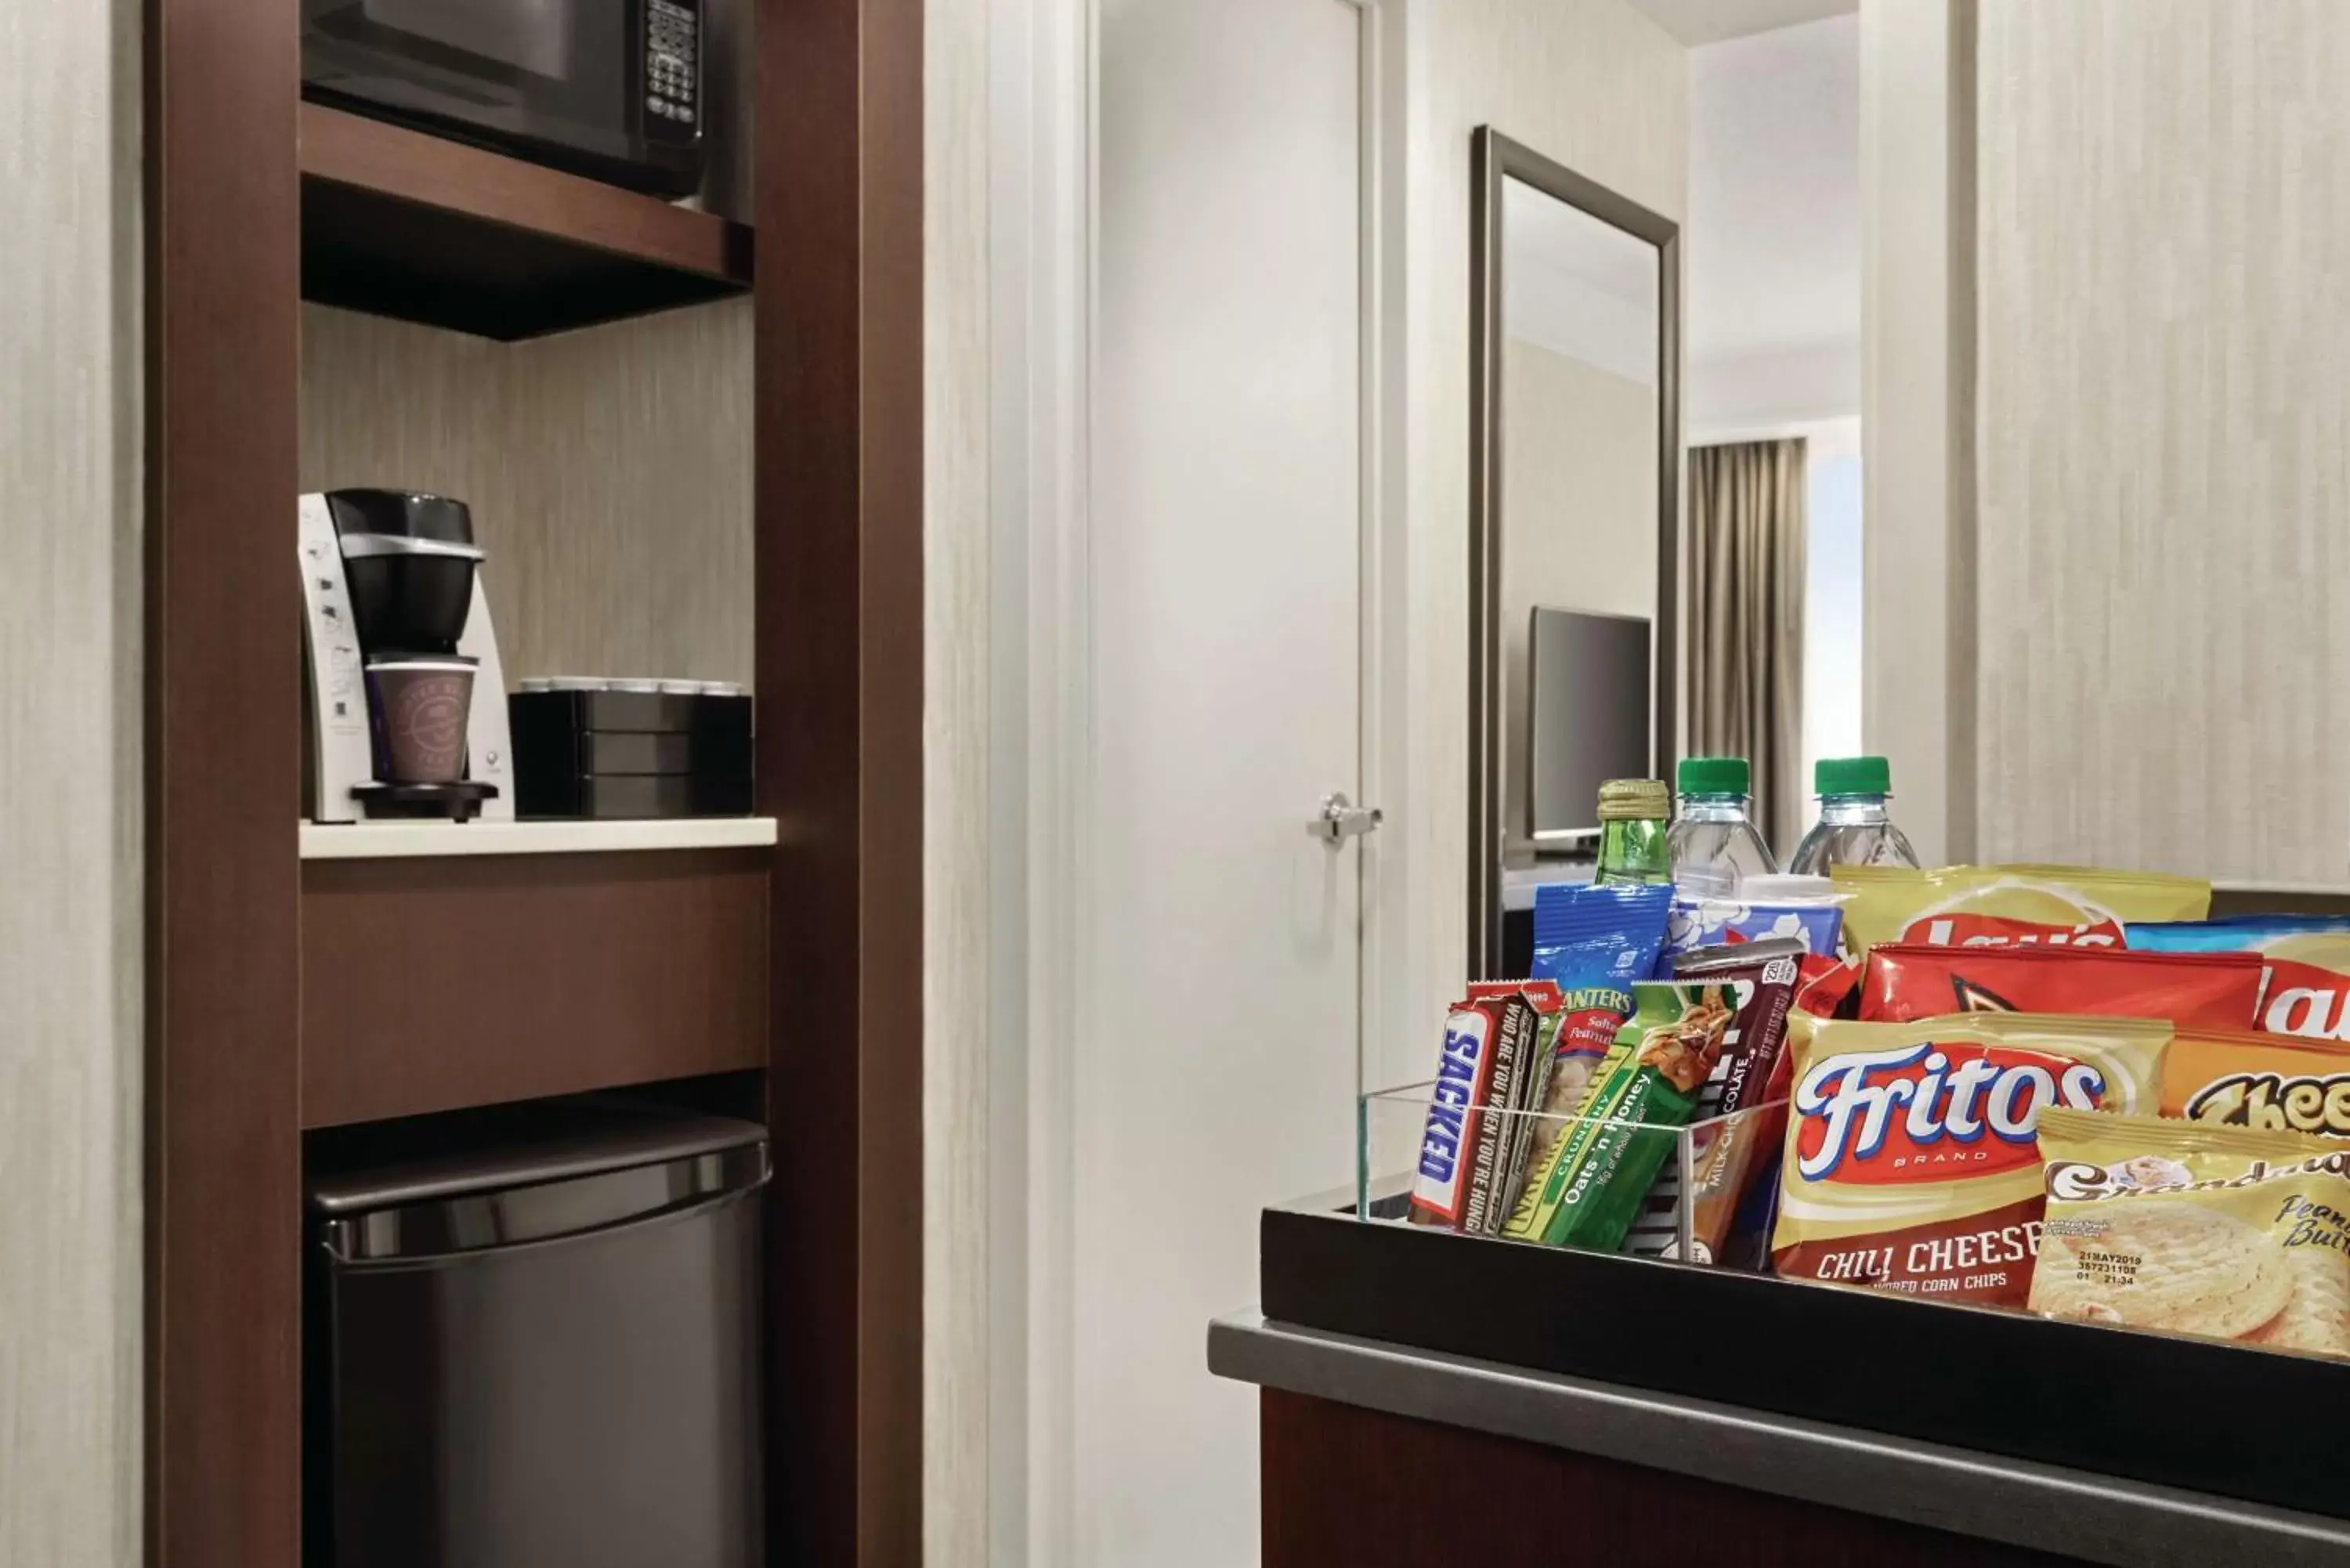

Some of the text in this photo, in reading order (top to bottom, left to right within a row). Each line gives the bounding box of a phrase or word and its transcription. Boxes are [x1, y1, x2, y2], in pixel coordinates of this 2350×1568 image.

[1502, 1003, 1522, 1035] WHO
[1563, 988, 1632, 1013] ANTERS
[1497, 1035, 1515, 1063] ARE
[1493, 1063, 1511, 1092] YOU
[1419, 1029, 1480, 1183] SACKED
[1482, 1093, 1508, 1132] WHEN
[1795, 1041, 2106, 1181] Fritos
[1558, 1094, 1609, 1176] CRUNCHY
[1564, 1160, 1598, 1205] Oats
[1603, 1073, 1651, 1132] Honey
[1472, 1134, 1496, 1188] YOU'RE
[1709, 1151, 1728, 1187] MILK
[1893, 1151, 1990, 1168] BRAND
[1466, 1188, 1489, 1231] HUNG
[1907, 1220, 2044, 1274] CHEESE
[1922, 1277, 1959, 1292] CORN
[1965, 1272, 2007, 1290] CHIPS
